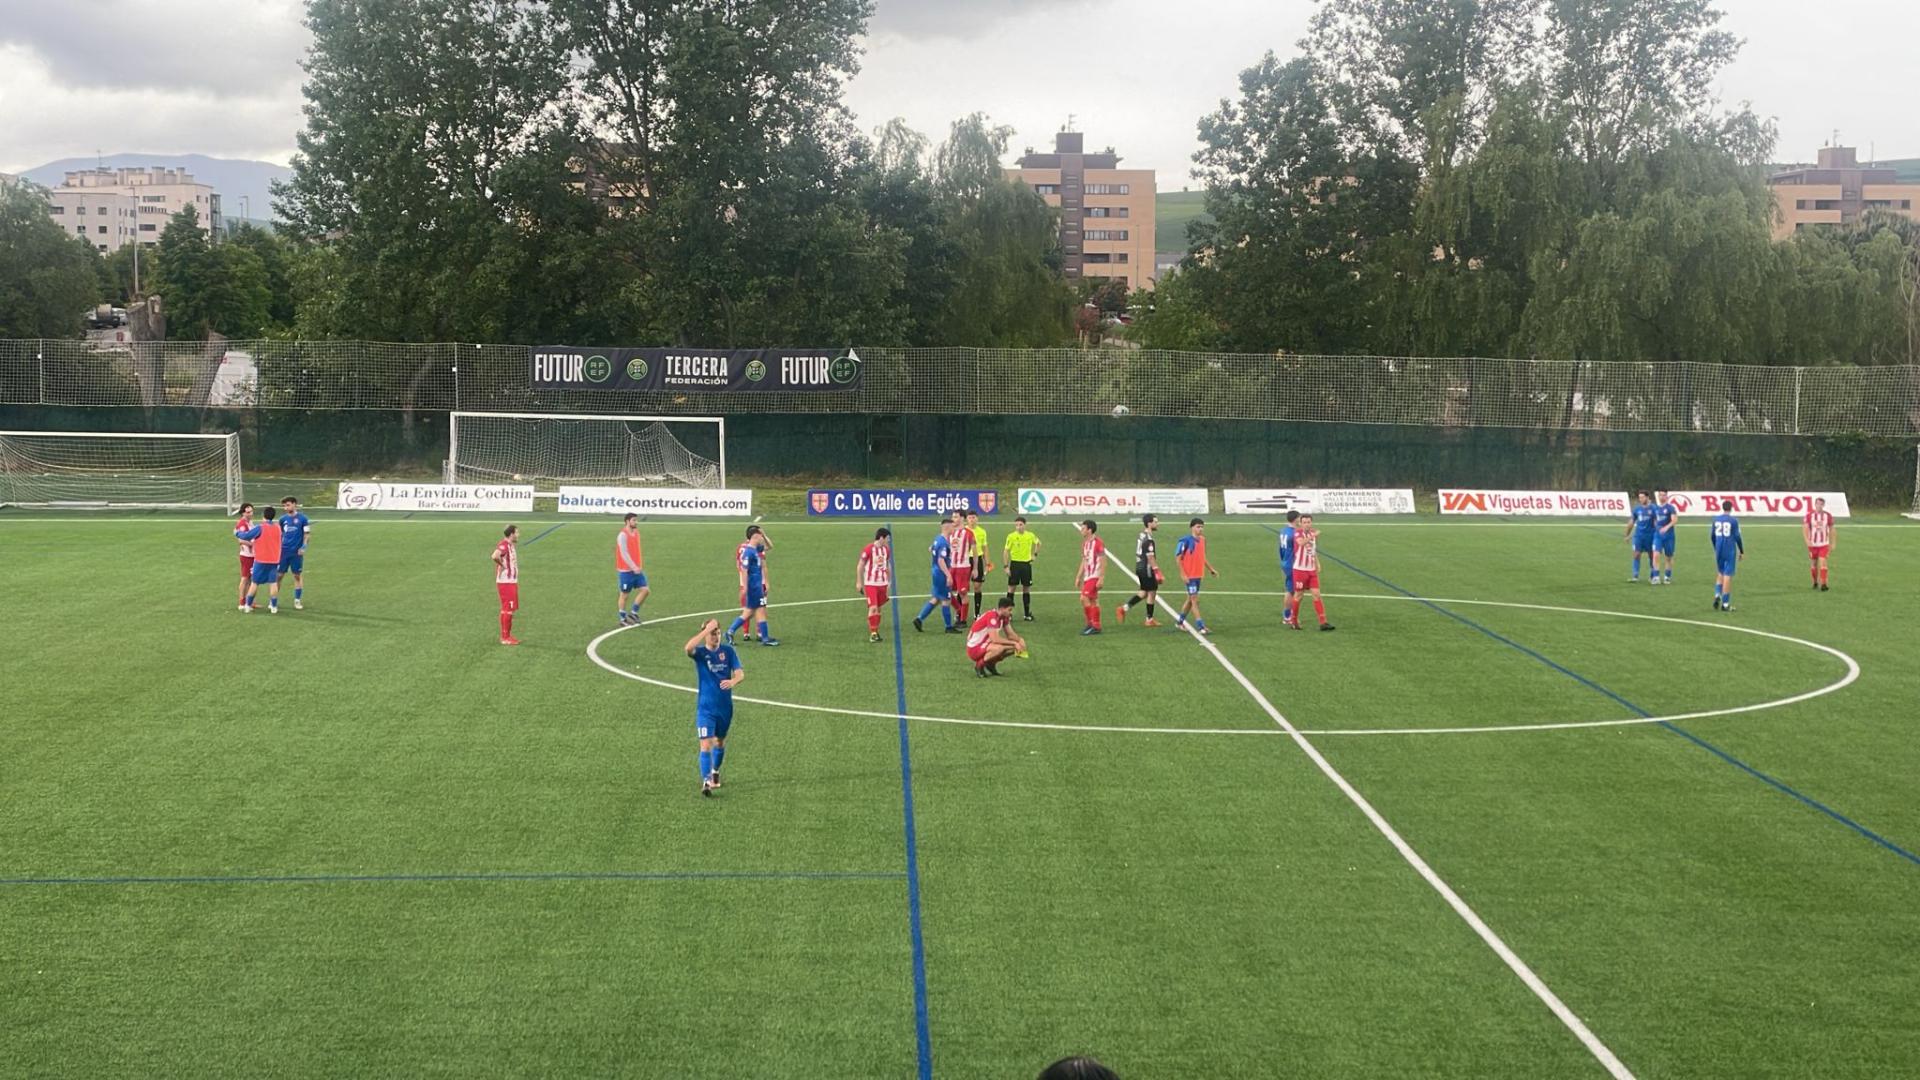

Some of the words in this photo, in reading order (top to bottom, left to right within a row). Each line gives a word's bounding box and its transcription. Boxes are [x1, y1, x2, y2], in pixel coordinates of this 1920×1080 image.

[665, 355, 728, 377] TERCERA
[664, 377, 729, 385] FEDERACIÓN
[390, 486, 408, 498] La
[413, 487, 467, 499] Envidia
[474, 487, 532, 500] Cochina
[560, 494, 748, 510] baluarteconstruccion.com
[834, 493, 848, 511] C.
[852, 494, 866, 511] D.
[870, 494, 902, 511] Valle
[907, 494, 924, 511] de
[927, 492, 970, 514] Egüés
[1050, 495, 1111, 507] ADISA
[1116, 495, 1142, 507] s.l.
[1488, 493, 1553, 513] Viguetas
[1559, 494, 1625, 511] Navarras
[1715, 521, 1731, 536] 28
